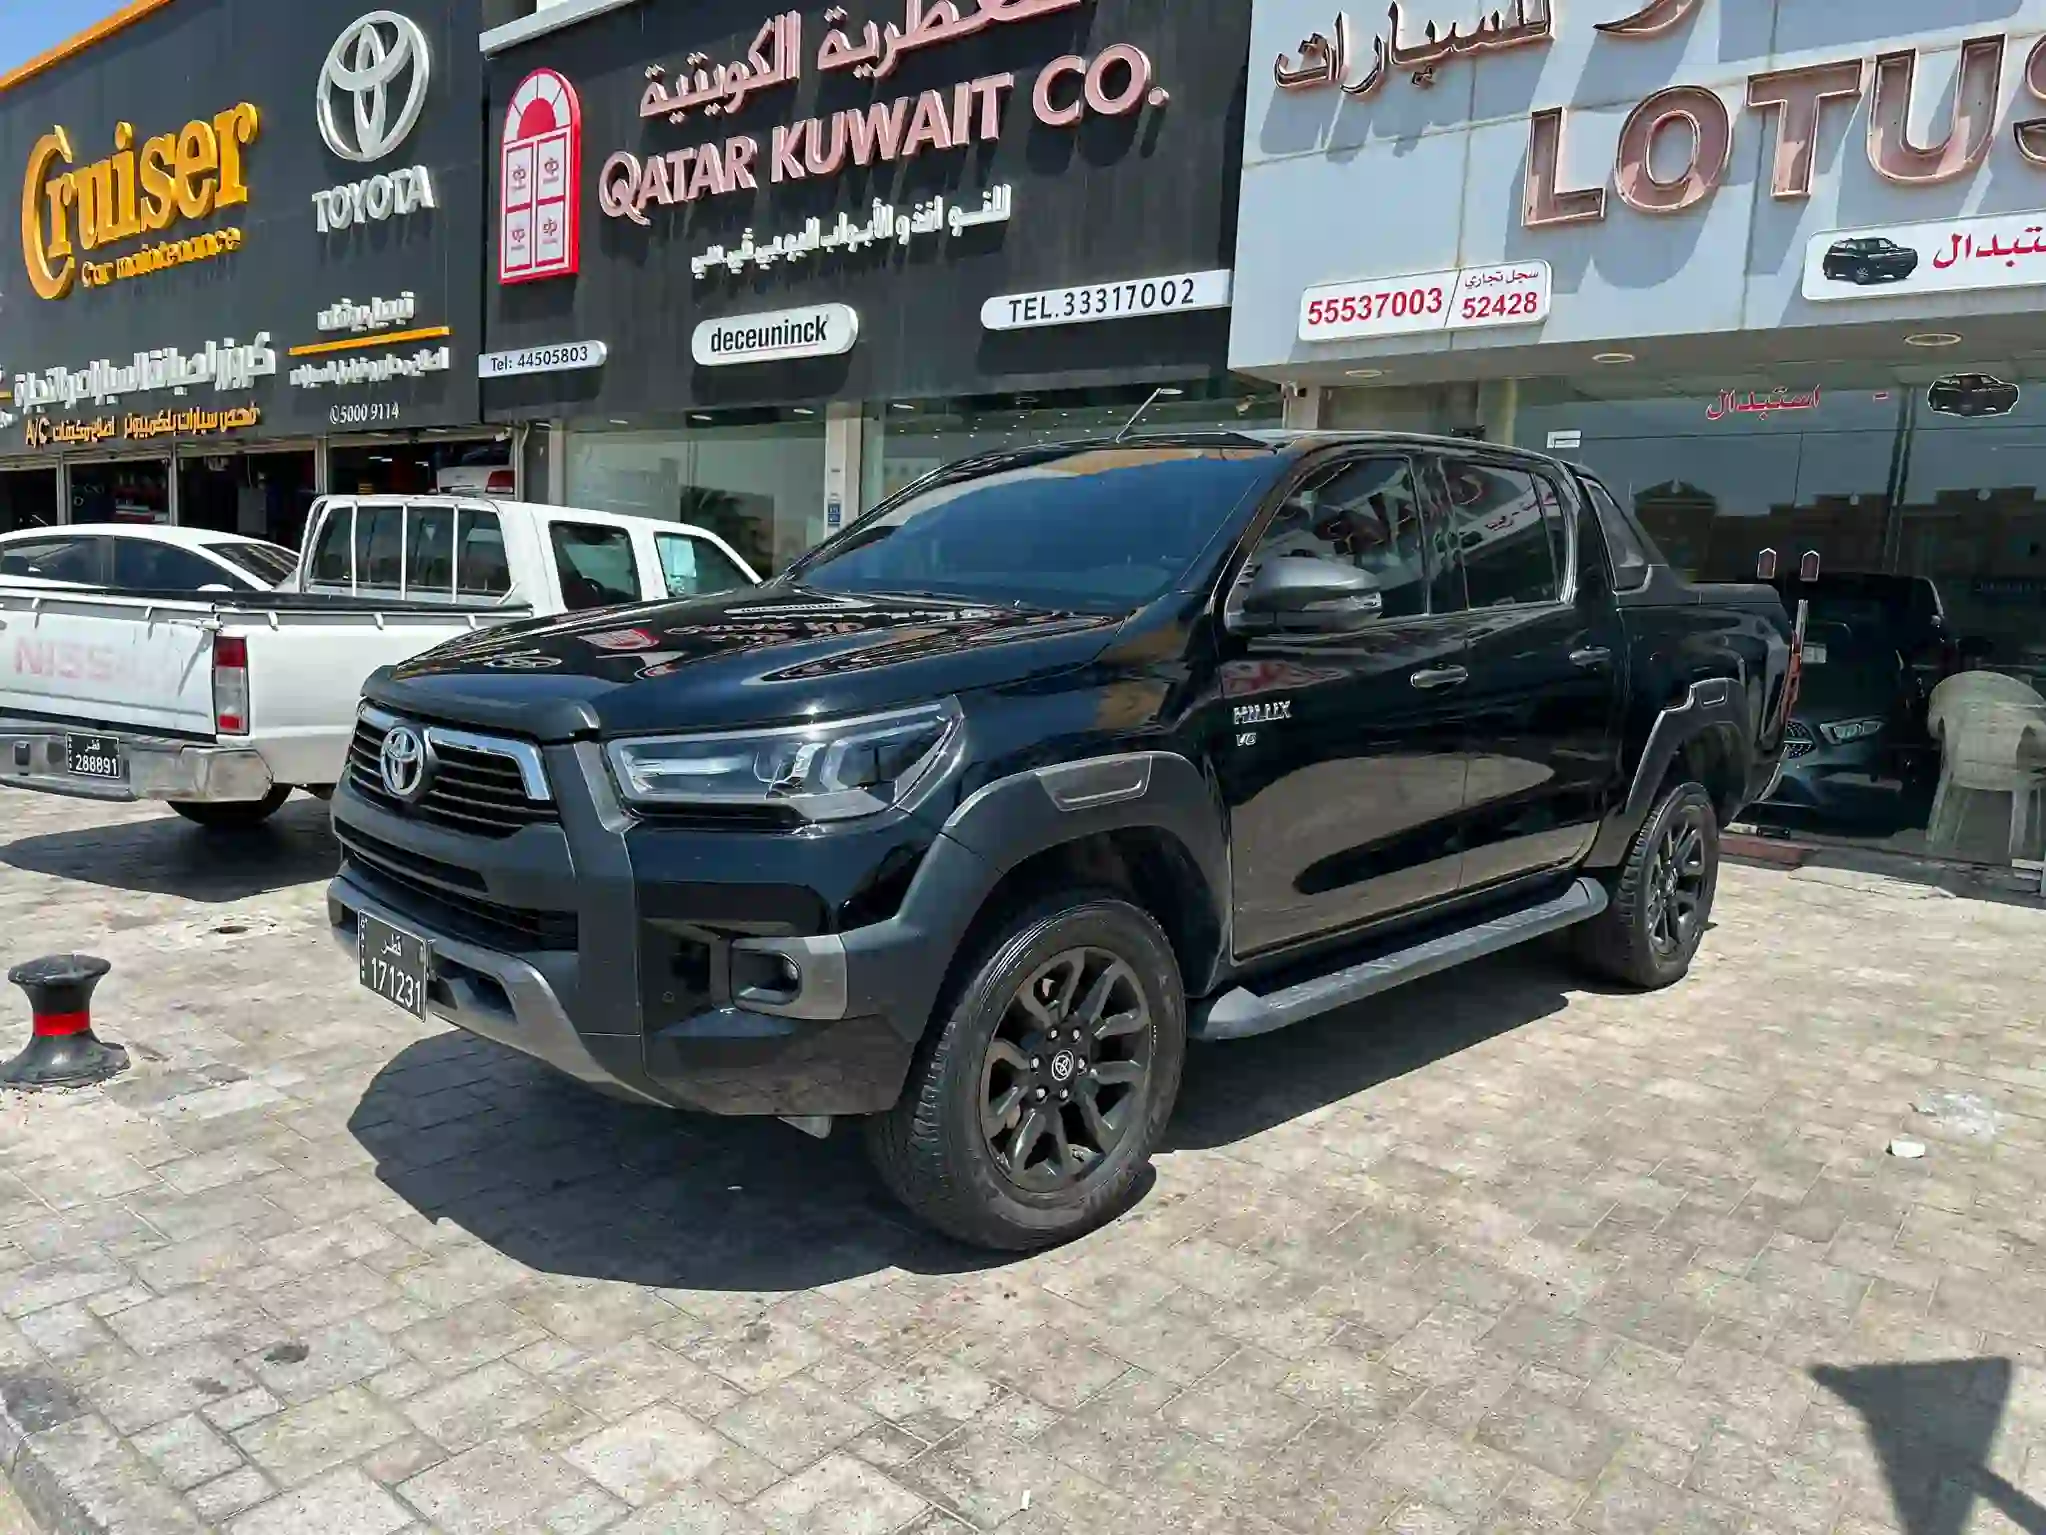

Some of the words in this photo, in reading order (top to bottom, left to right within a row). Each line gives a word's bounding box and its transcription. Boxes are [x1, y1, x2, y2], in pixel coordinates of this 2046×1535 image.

[639, 9, 801, 124] الكويتية
[599, 134, 758, 226] QATAR
[770, 71, 1014, 184] KUWAIT
[1032, 42, 1170, 127] CO.
[21, 101, 260, 299] Cruiser
[311, 165, 436, 233] TOYOTA
[81, 260, 114, 287] Car
[116, 227, 241, 279] maintenance
[1464, 271, 1503, 290] تجاري
[1506, 268, 1540, 285] سجل
[1307, 287, 1443, 326] 55537003
[1462, 291, 1538, 319] 52428
[711, 315, 829, 353] deceuninck
[491, 355, 513, 371] Tel:
[517, 345, 588, 368] 44505803
[340, 405, 367, 424] 5000
[371, 402, 400, 420] 9114
[1705, 384, 1820, 420] استبدال
[1233, 700, 1292, 725] HILUX
[1236, 732, 1257, 747] V6
[381, 933, 402, 957] قطر
[371, 957, 422, 1013] 171231
